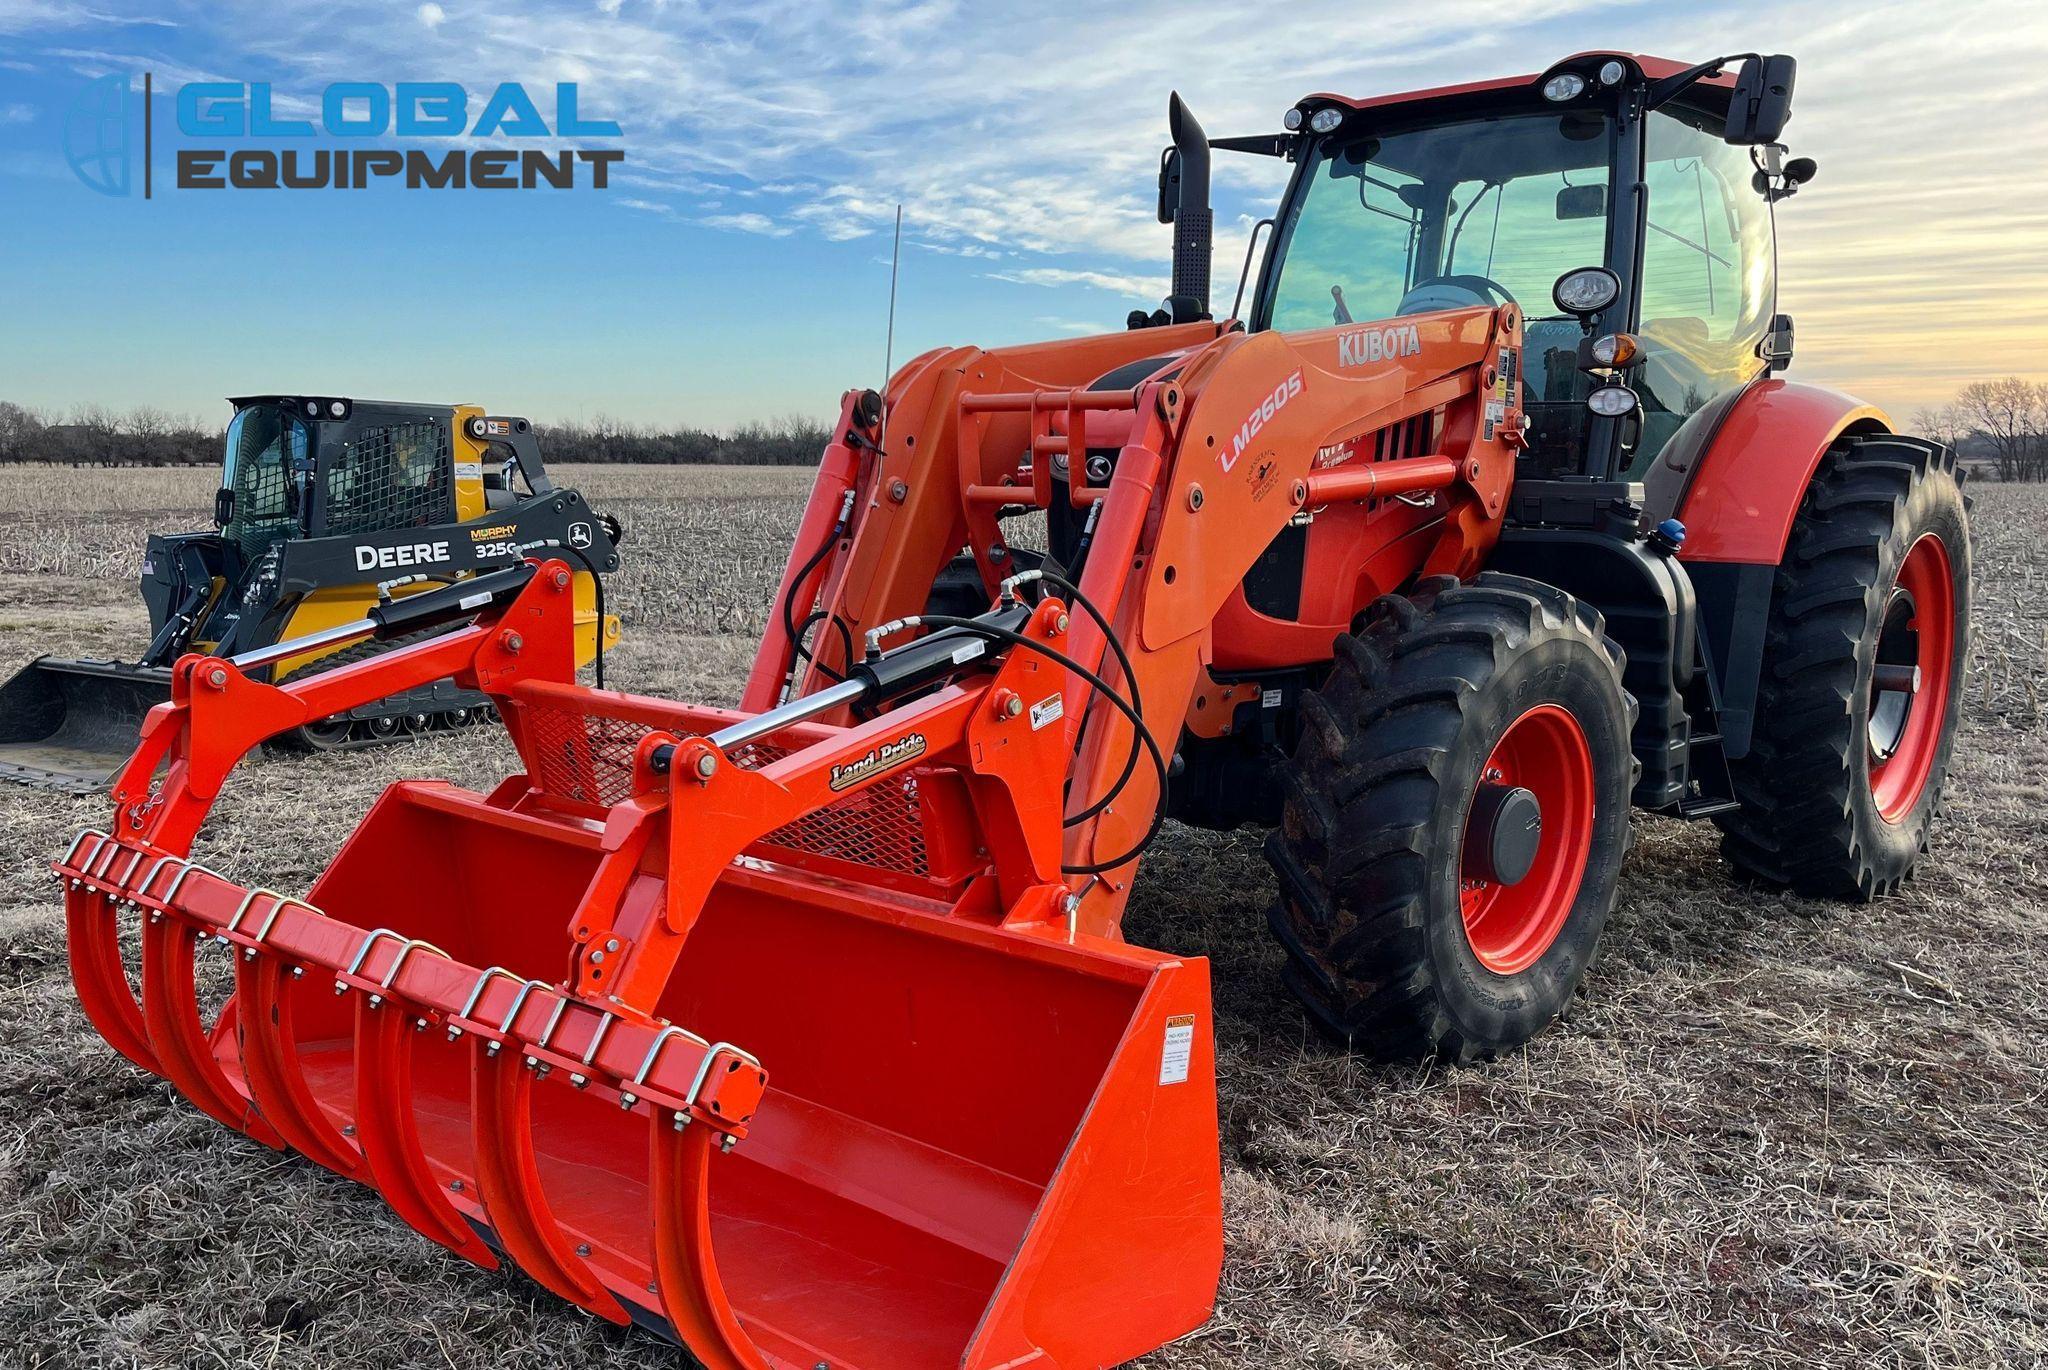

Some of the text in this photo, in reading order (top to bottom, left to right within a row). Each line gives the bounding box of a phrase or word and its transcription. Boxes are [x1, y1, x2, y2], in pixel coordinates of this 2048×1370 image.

[1338, 324, 1421, 368] KUBOTA
[1220, 371, 1301, 473] LM2605
[470, 525, 518, 539] MURPHY
[354, 541, 451, 571] DEERE
[831, 734, 924, 783] Land Pride
